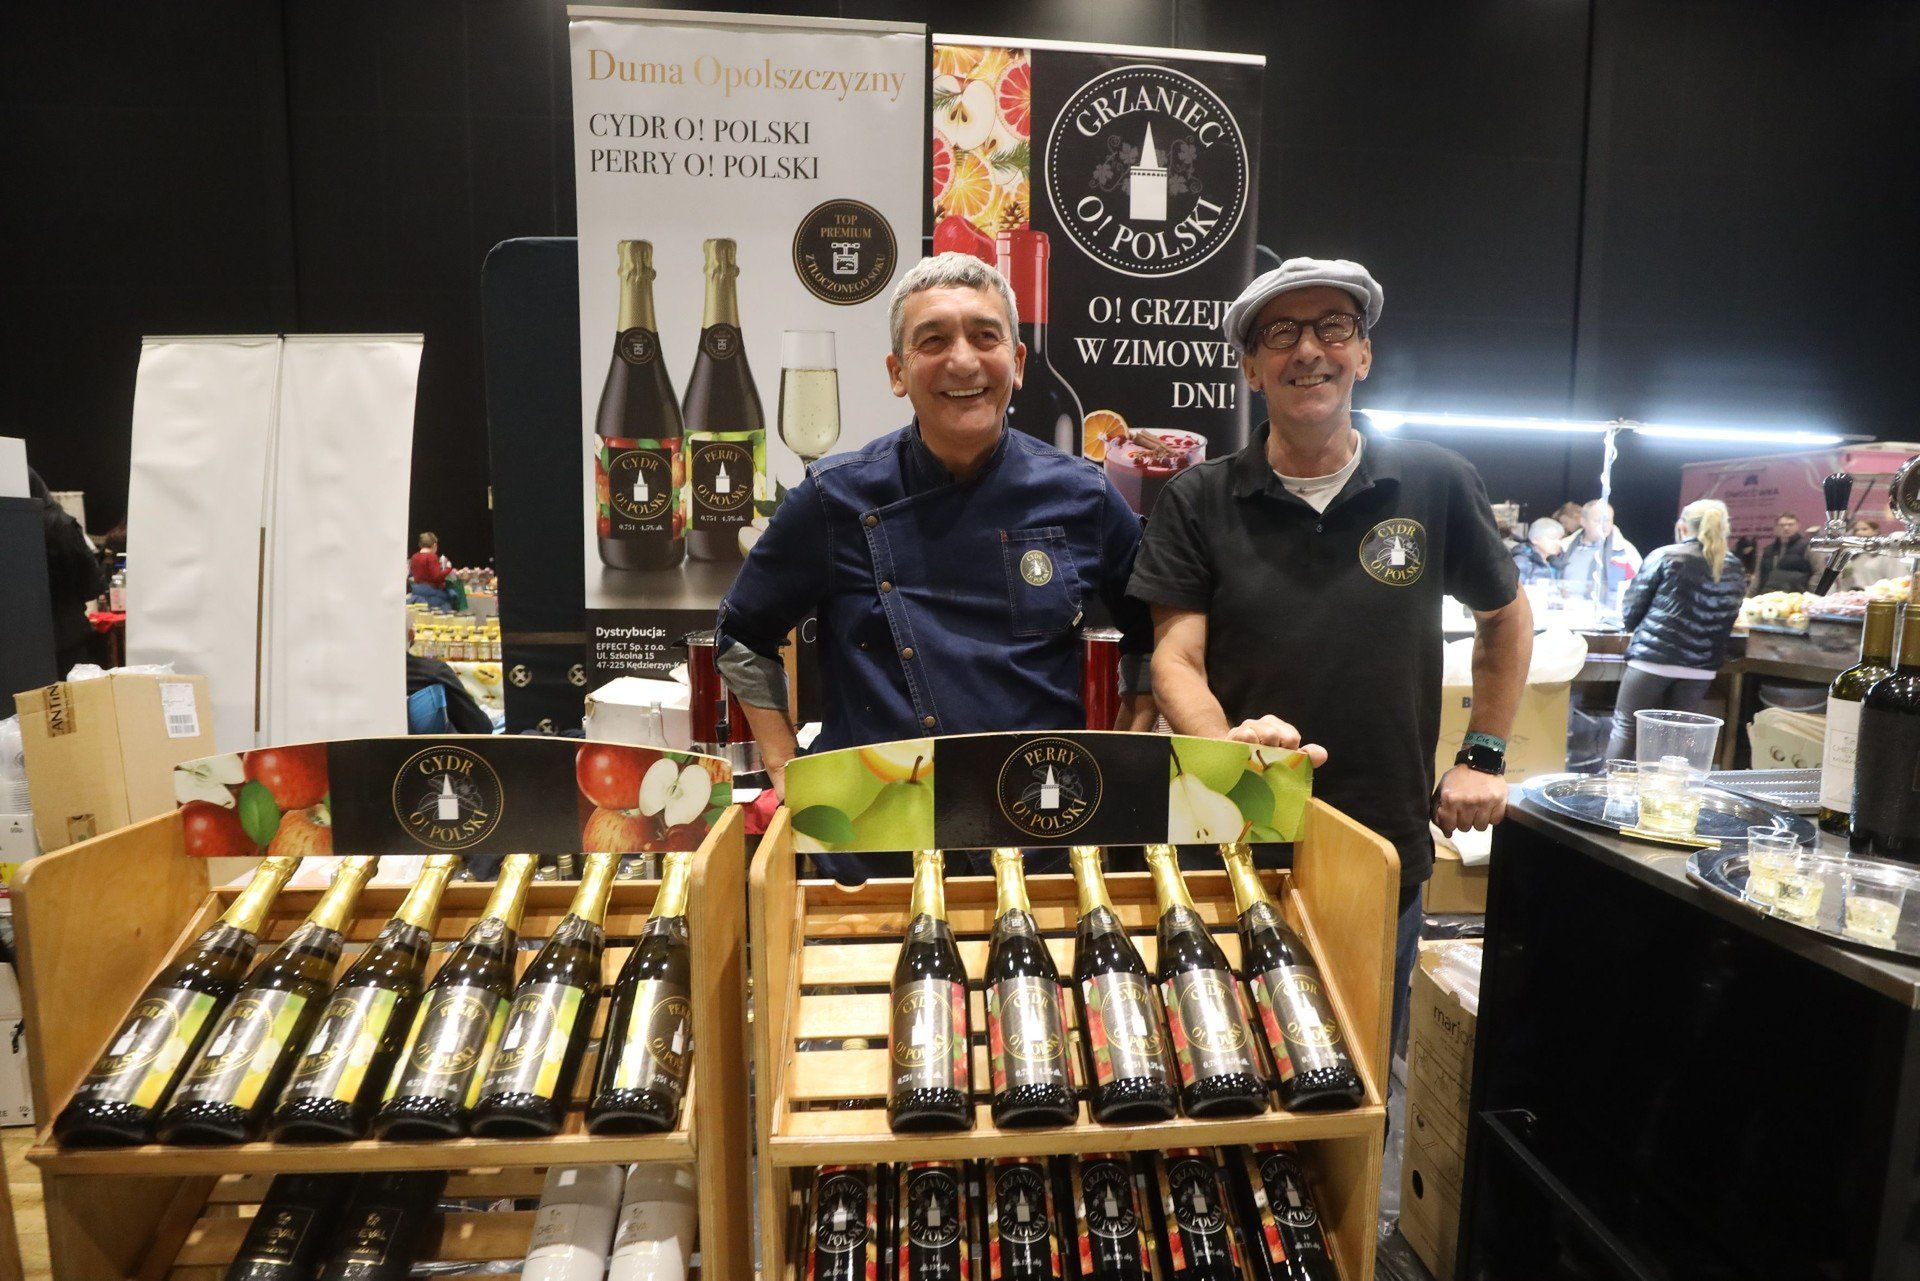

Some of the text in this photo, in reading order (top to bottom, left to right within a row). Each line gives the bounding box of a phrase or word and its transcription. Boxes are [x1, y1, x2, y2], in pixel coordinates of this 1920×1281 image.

[588, 49, 906, 102] Duma Opolszczyzny
[1076, 85, 1225, 148] GRZANIEC
[589, 113, 811, 144] CYDR O! POLSKI
[590, 149, 820, 179] PERRY O! POLSKI
[834, 214, 858, 225] TOP
[1077, 196, 1223, 260] O! POLSKI
[820, 227, 872, 238] PREMIUM
[1089, 296, 1121, 324] O!
[1074, 337, 1239, 369] W ZIMOWE
[1171, 381, 1236, 410] DNI!
[622, 457, 660, 472] CYDR
[704, 450, 742, 463] PERRY
[627, 492, 667, 515] POLSKI
[708, 484, 748, 506] POLSKI
[1378, 525, 1416, 537] CYDR
[595, 627, 666, 639] Dystrybucja:
[596, 643, 628, 651] EFFECT
[629, 643, 643, 652] Sp.
[596, 652, 655, 660] Ul. Szkolna 15
[596, 661, 625, 669] 47-225
[419, 755, 474, 775] CYDR
[1024, 746, 1079, 767] PERRY
[1012, 798, 1087, 829] O! POLSKI
[429, 809, 488, 841] POLSKI
